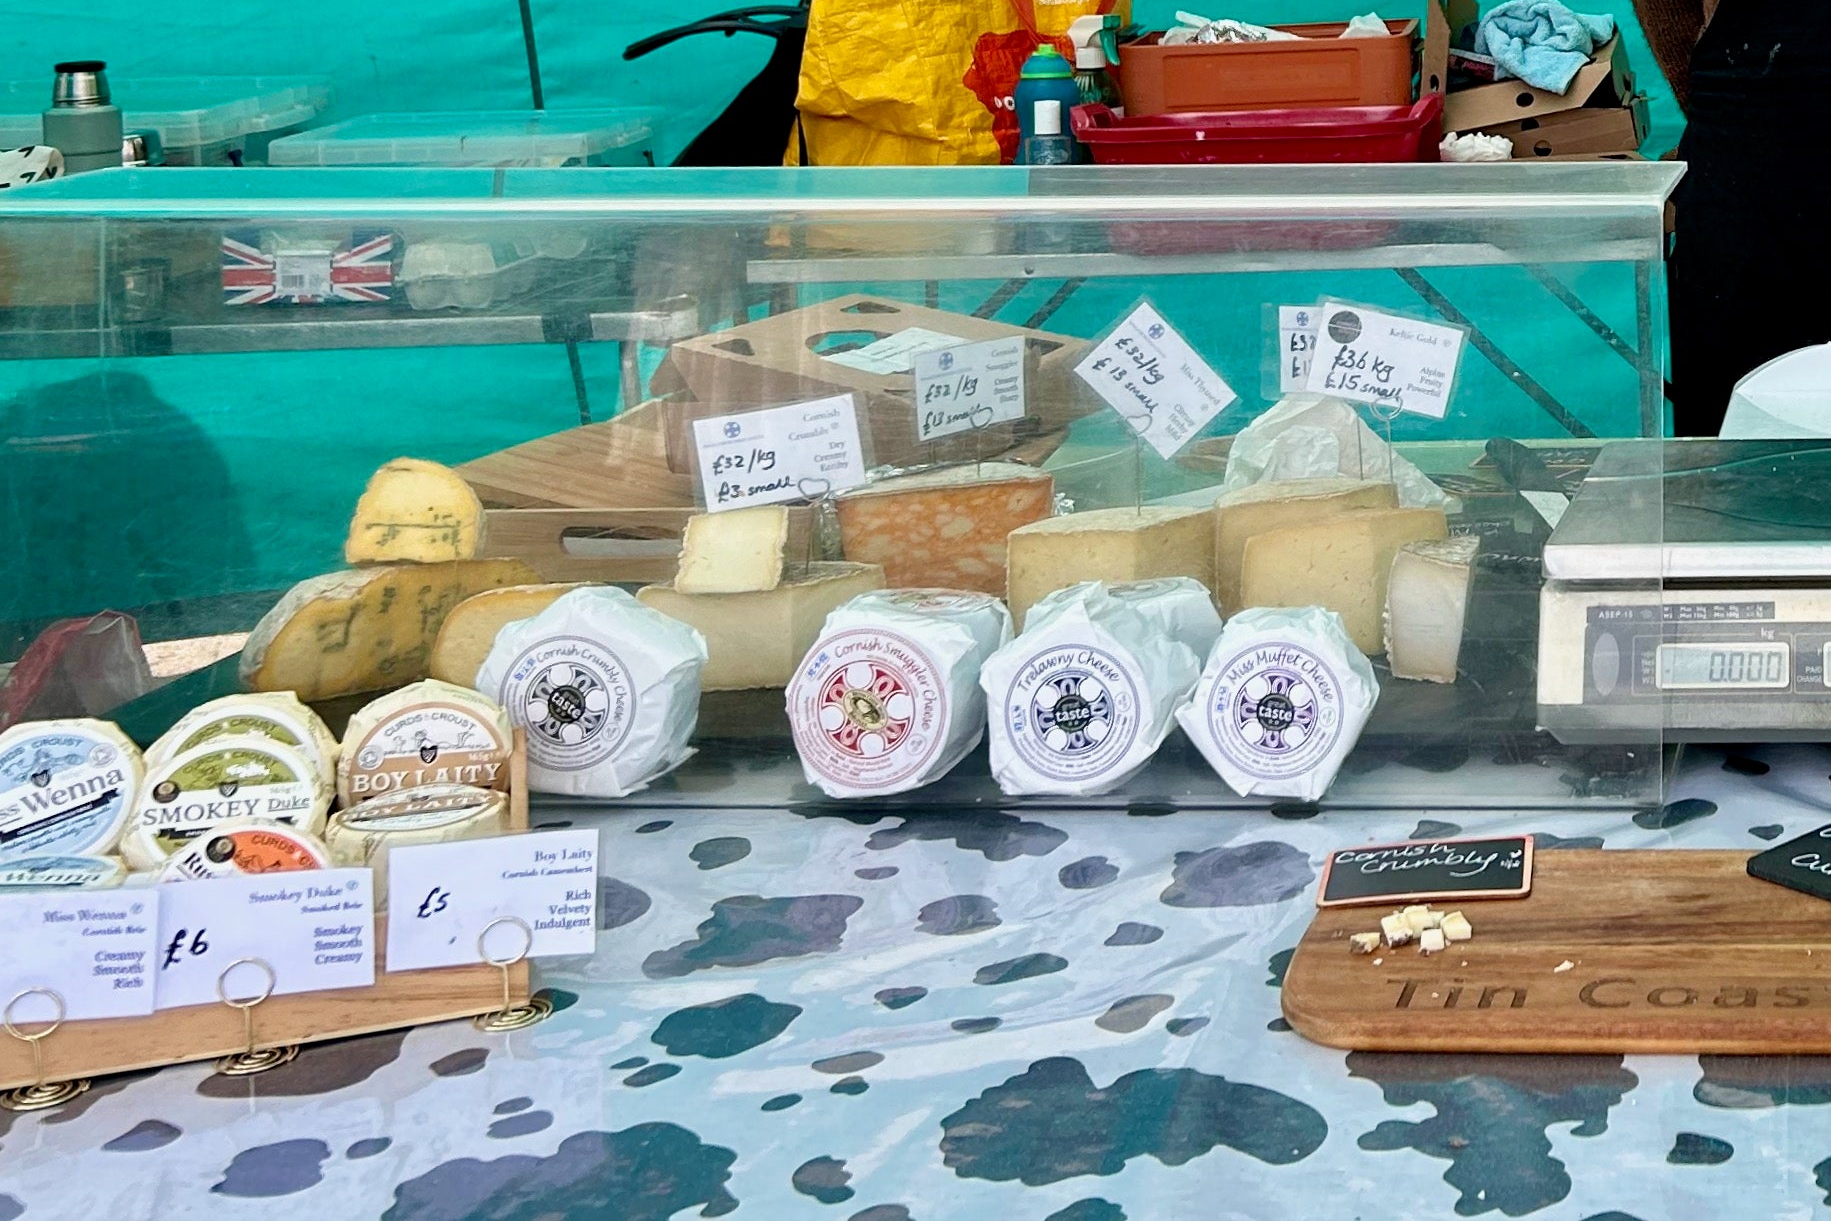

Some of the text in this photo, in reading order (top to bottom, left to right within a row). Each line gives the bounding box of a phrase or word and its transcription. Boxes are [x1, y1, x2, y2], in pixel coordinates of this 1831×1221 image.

[747, 476, 797, 497] small
[1760, 627, 1775, 640] kg
[536, 644, 581, 664] Cornish
[581, 647, 620, 685] Crumbly
[614, 684, 627, 722] Cheese
[833, 637, 884, 659] Cornish
[883, 642, 930, 686] Smuggler
[921, 689, 937, 730] Cheese
[1016, 650, 1121, 692] Trelawny Cheese
[1226, 648, 1334, 703] Miss Muffet Cheese
[550, 690, 583, 719] taste
[1055, 705, 1091, 722] taste
[1258, 703, 1293, 721] taste
[384, 713, 424, 737] CURDS
[431, 712, 478, 730] CROUST
[351, 762, 503, 794] BOY LAITY
[0, 768, 125, 820] ss Wenna
[142, 795, 310, 827] SMOKEY Duke
[251, 833, 296, 855] CURDS
[534, 850, 558, 864] Boy
[416, 886, 451, 919] £5
[549, 903, 592, 916] Velvety
[565, 889, 592, 902] Rich
[534, 916, 591, 931] Indulgent
[161, 927, 209, 970] £6
[1388, 977, 1528, 1010] Tin
